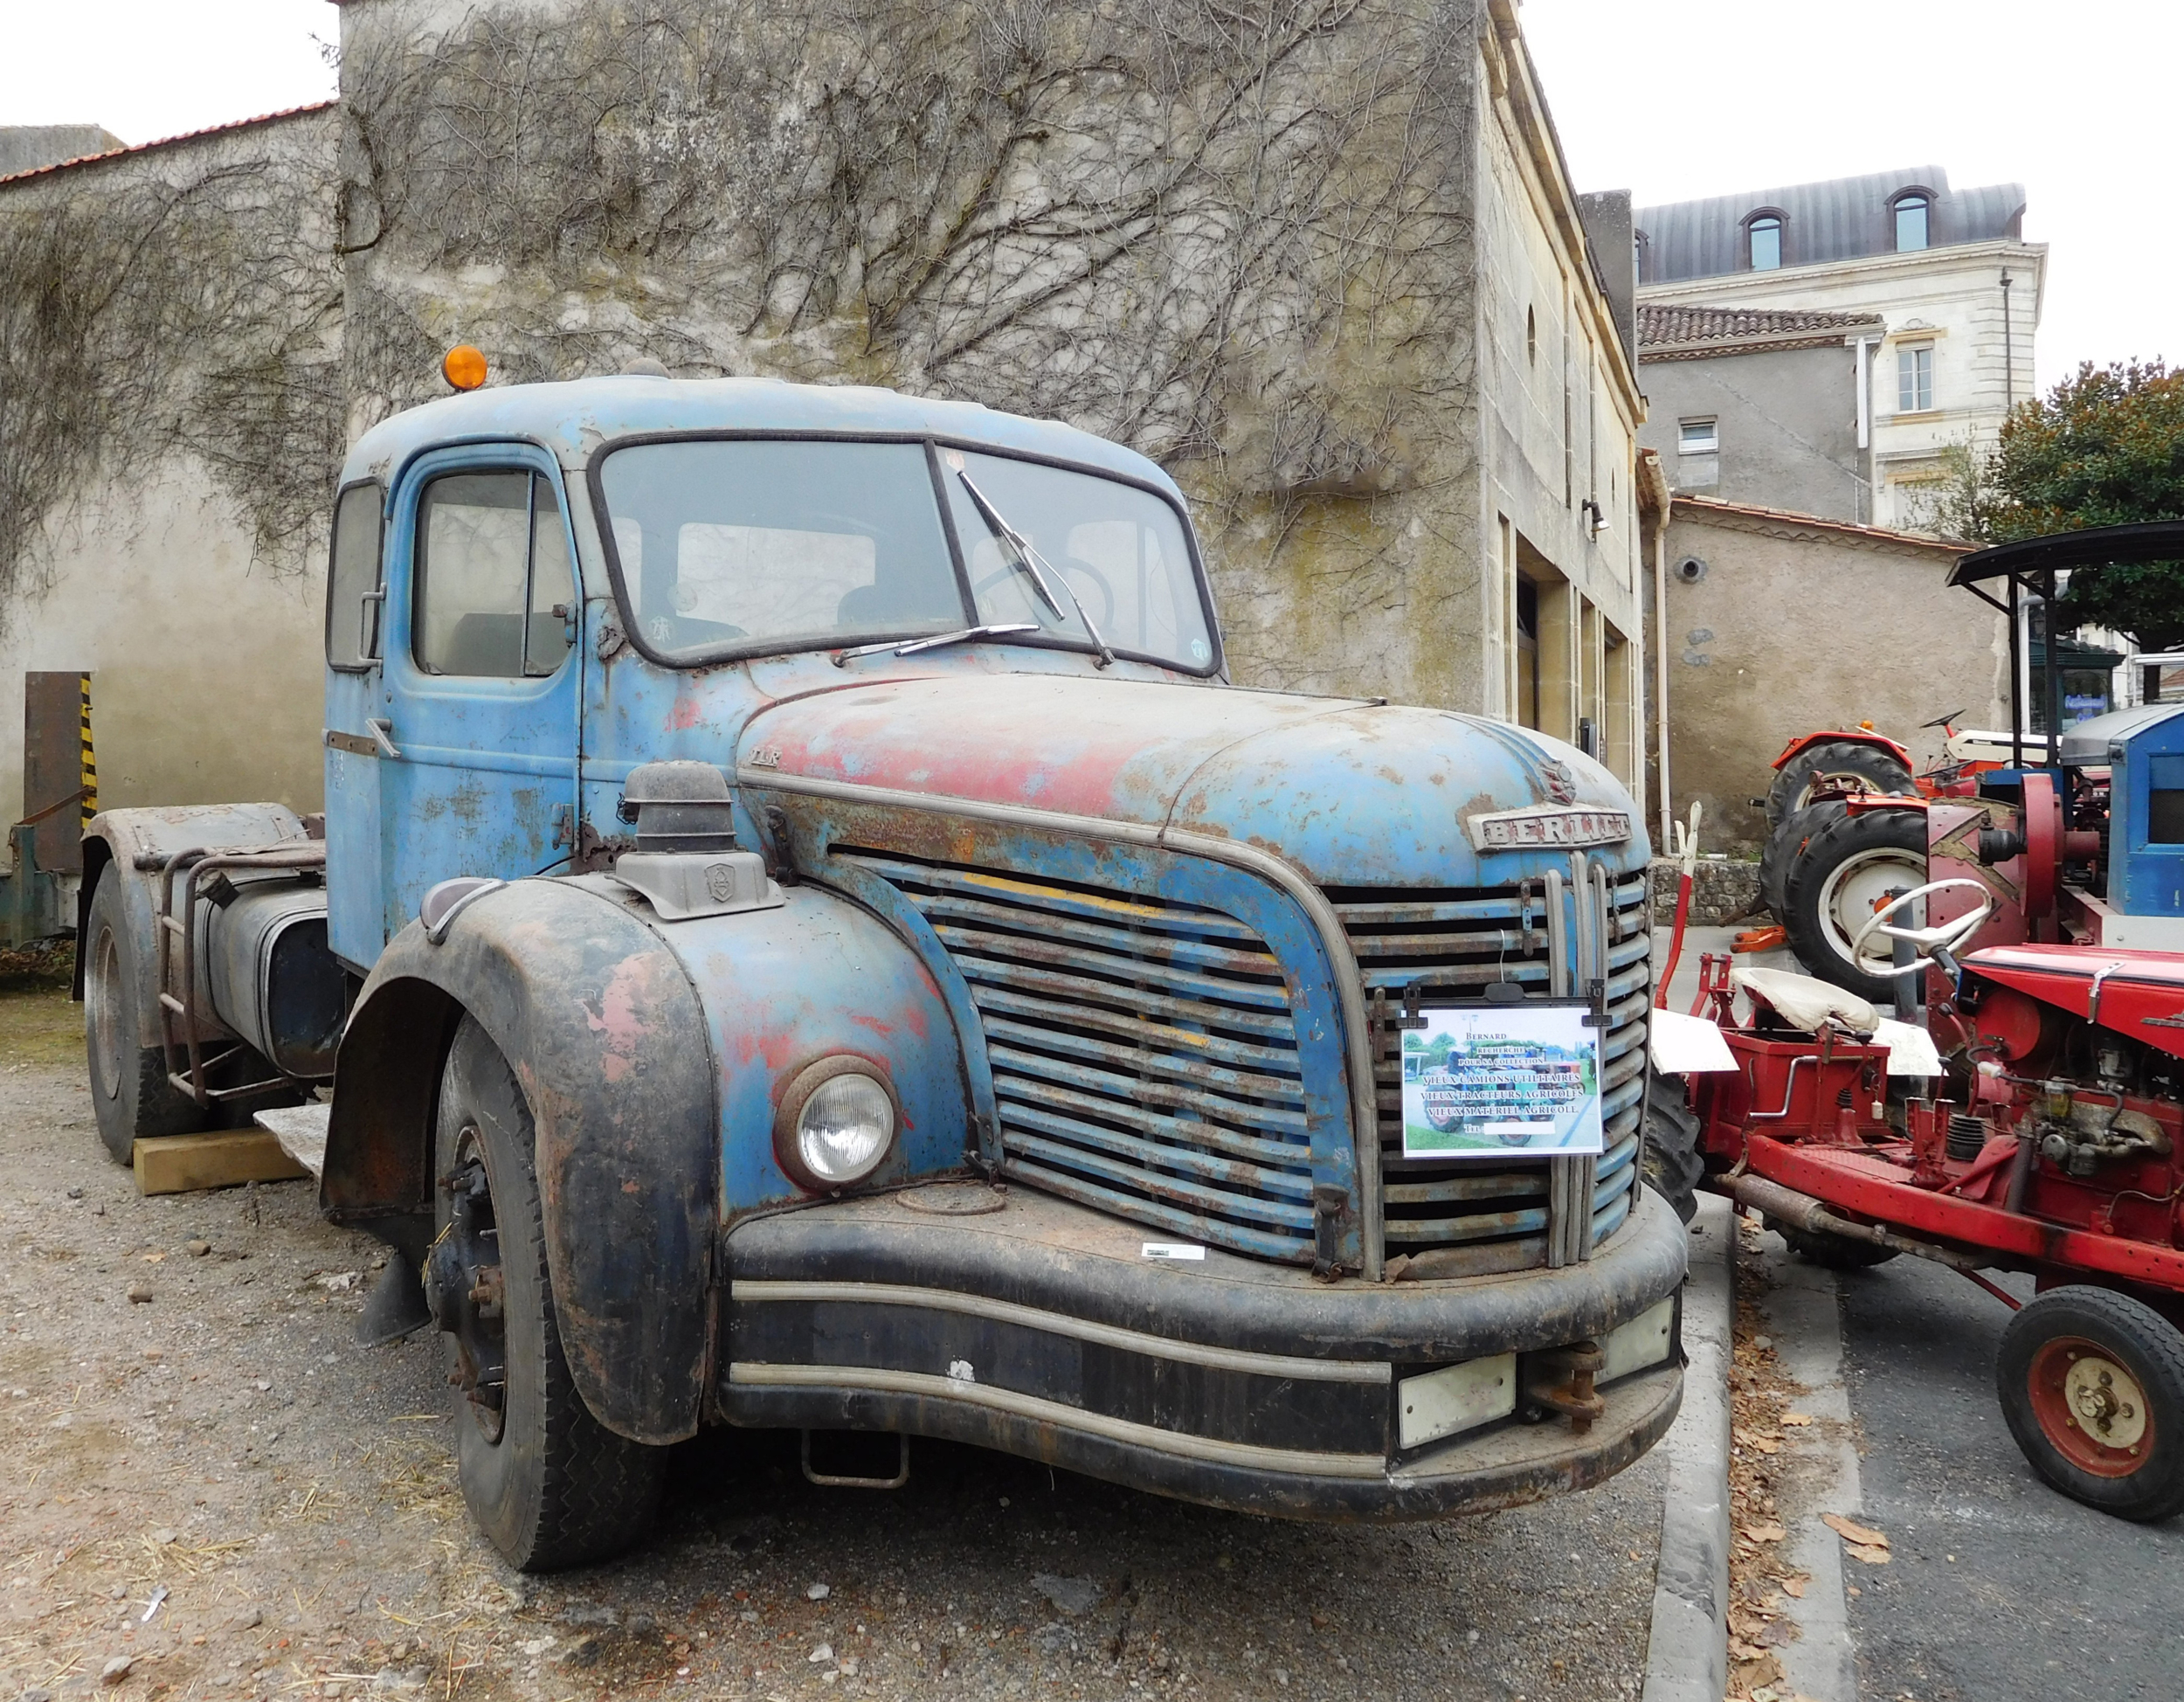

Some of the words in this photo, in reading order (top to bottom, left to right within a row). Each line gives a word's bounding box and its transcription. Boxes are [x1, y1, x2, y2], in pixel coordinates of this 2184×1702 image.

[1484, 814, 1630, 845] BERLIET
[1513, 1074, 1580, 1083] UTILITAIRES
[1465, 1105, 1518, 1116] MATÉRIEL
